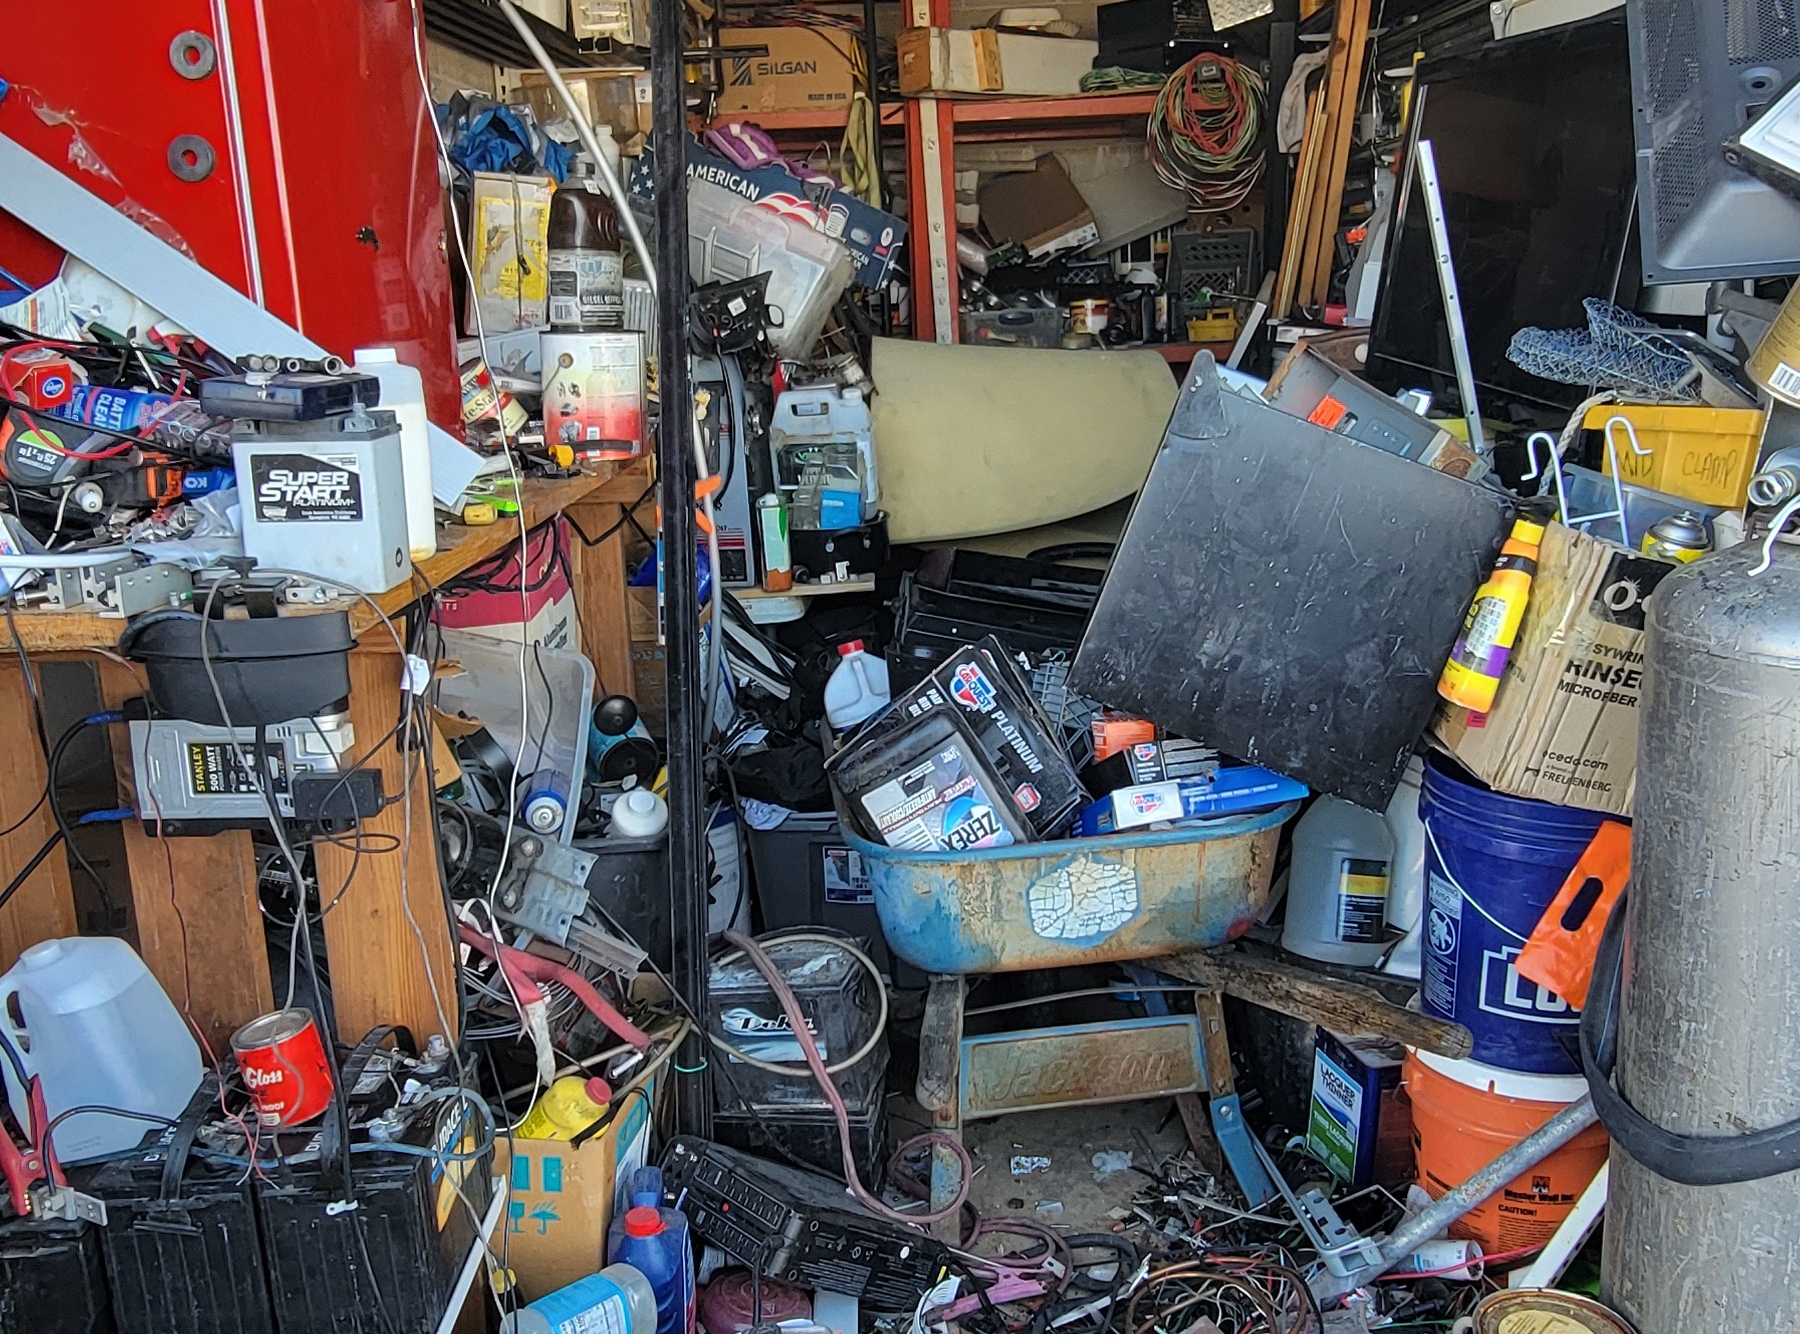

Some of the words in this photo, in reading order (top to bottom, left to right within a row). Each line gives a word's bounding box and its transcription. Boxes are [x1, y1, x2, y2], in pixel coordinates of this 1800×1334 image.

[686, 163, 761, 201] AMERICAN
[268, 469, 349, 485] SUPER
[1681, 449, 1738, 489] CLAMP
[259, 483, 350, 502] START
[1564, 659, 1643, 691] RINSE
[991, 710, 1044, 774] PLATINUM
[192, 747, 206, 792] STANLEY
[206, 746, 216, 772] WATT
[209, 773, 219, 791] 500
[1542, 771, 1612, 792] FREUENBERG
[940, 810, 1001, 851] ZEREX
[245, 1067, 283, 1089] Gloss
[1320, 1062, 1355, 1098] LACQUER
[1321, 1074, 1354, 1110] THINNER
[1498, 1204, 1538, 1216] CAUTION!
